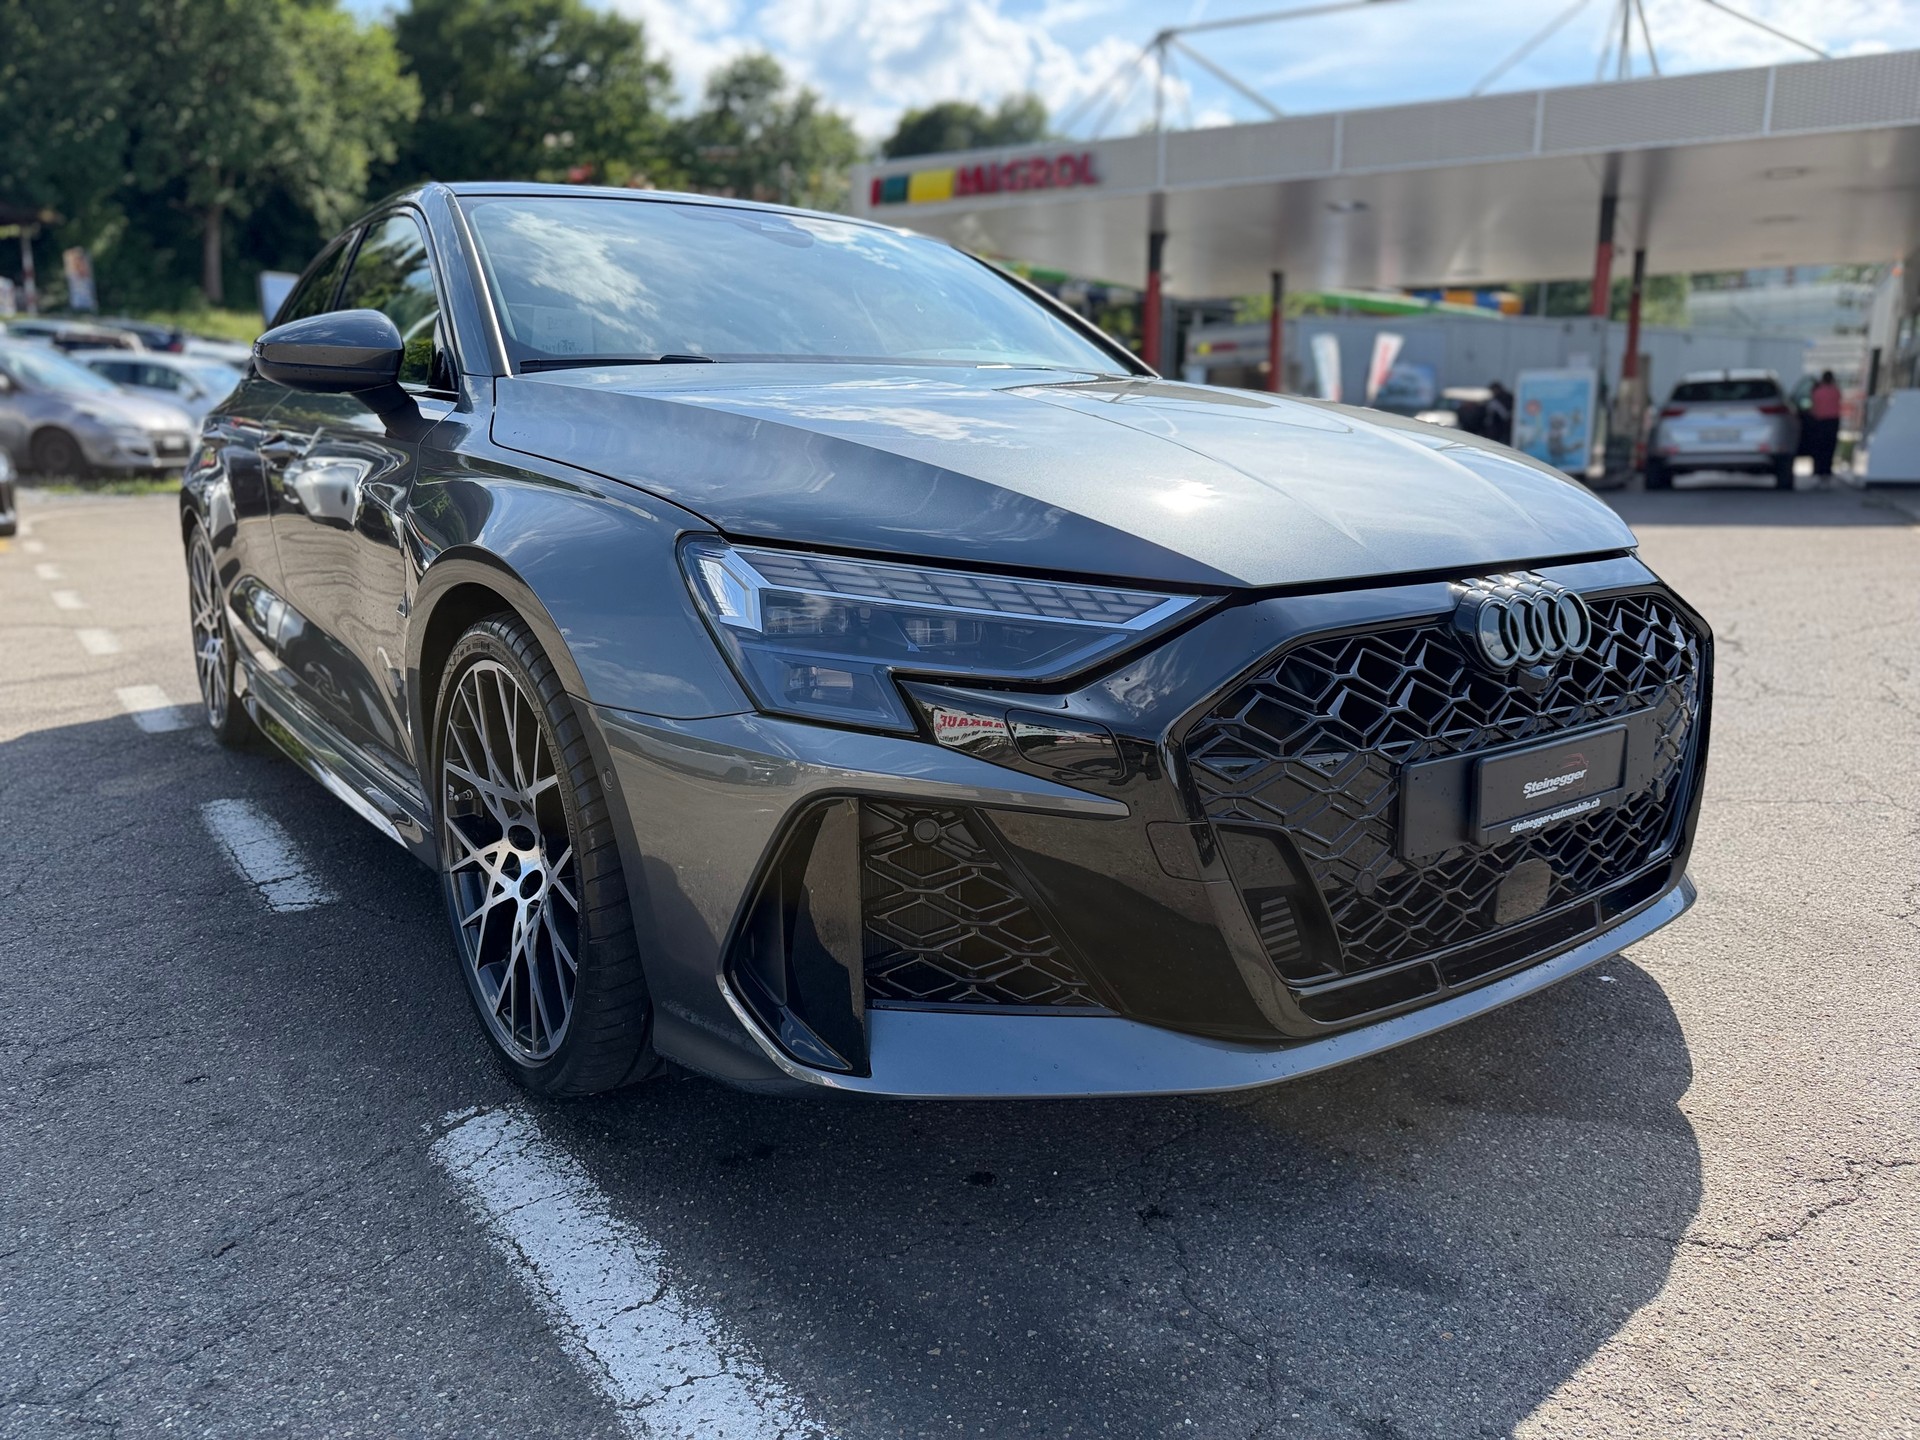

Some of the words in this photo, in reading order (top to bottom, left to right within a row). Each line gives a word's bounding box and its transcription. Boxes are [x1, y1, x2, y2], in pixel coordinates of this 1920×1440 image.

[955, 153, 1099, 196] MIGROL
[1523, 769, 1587, 794] Steinegger
[1510, 798, 1600, 833] steinegger-automobile.ch
